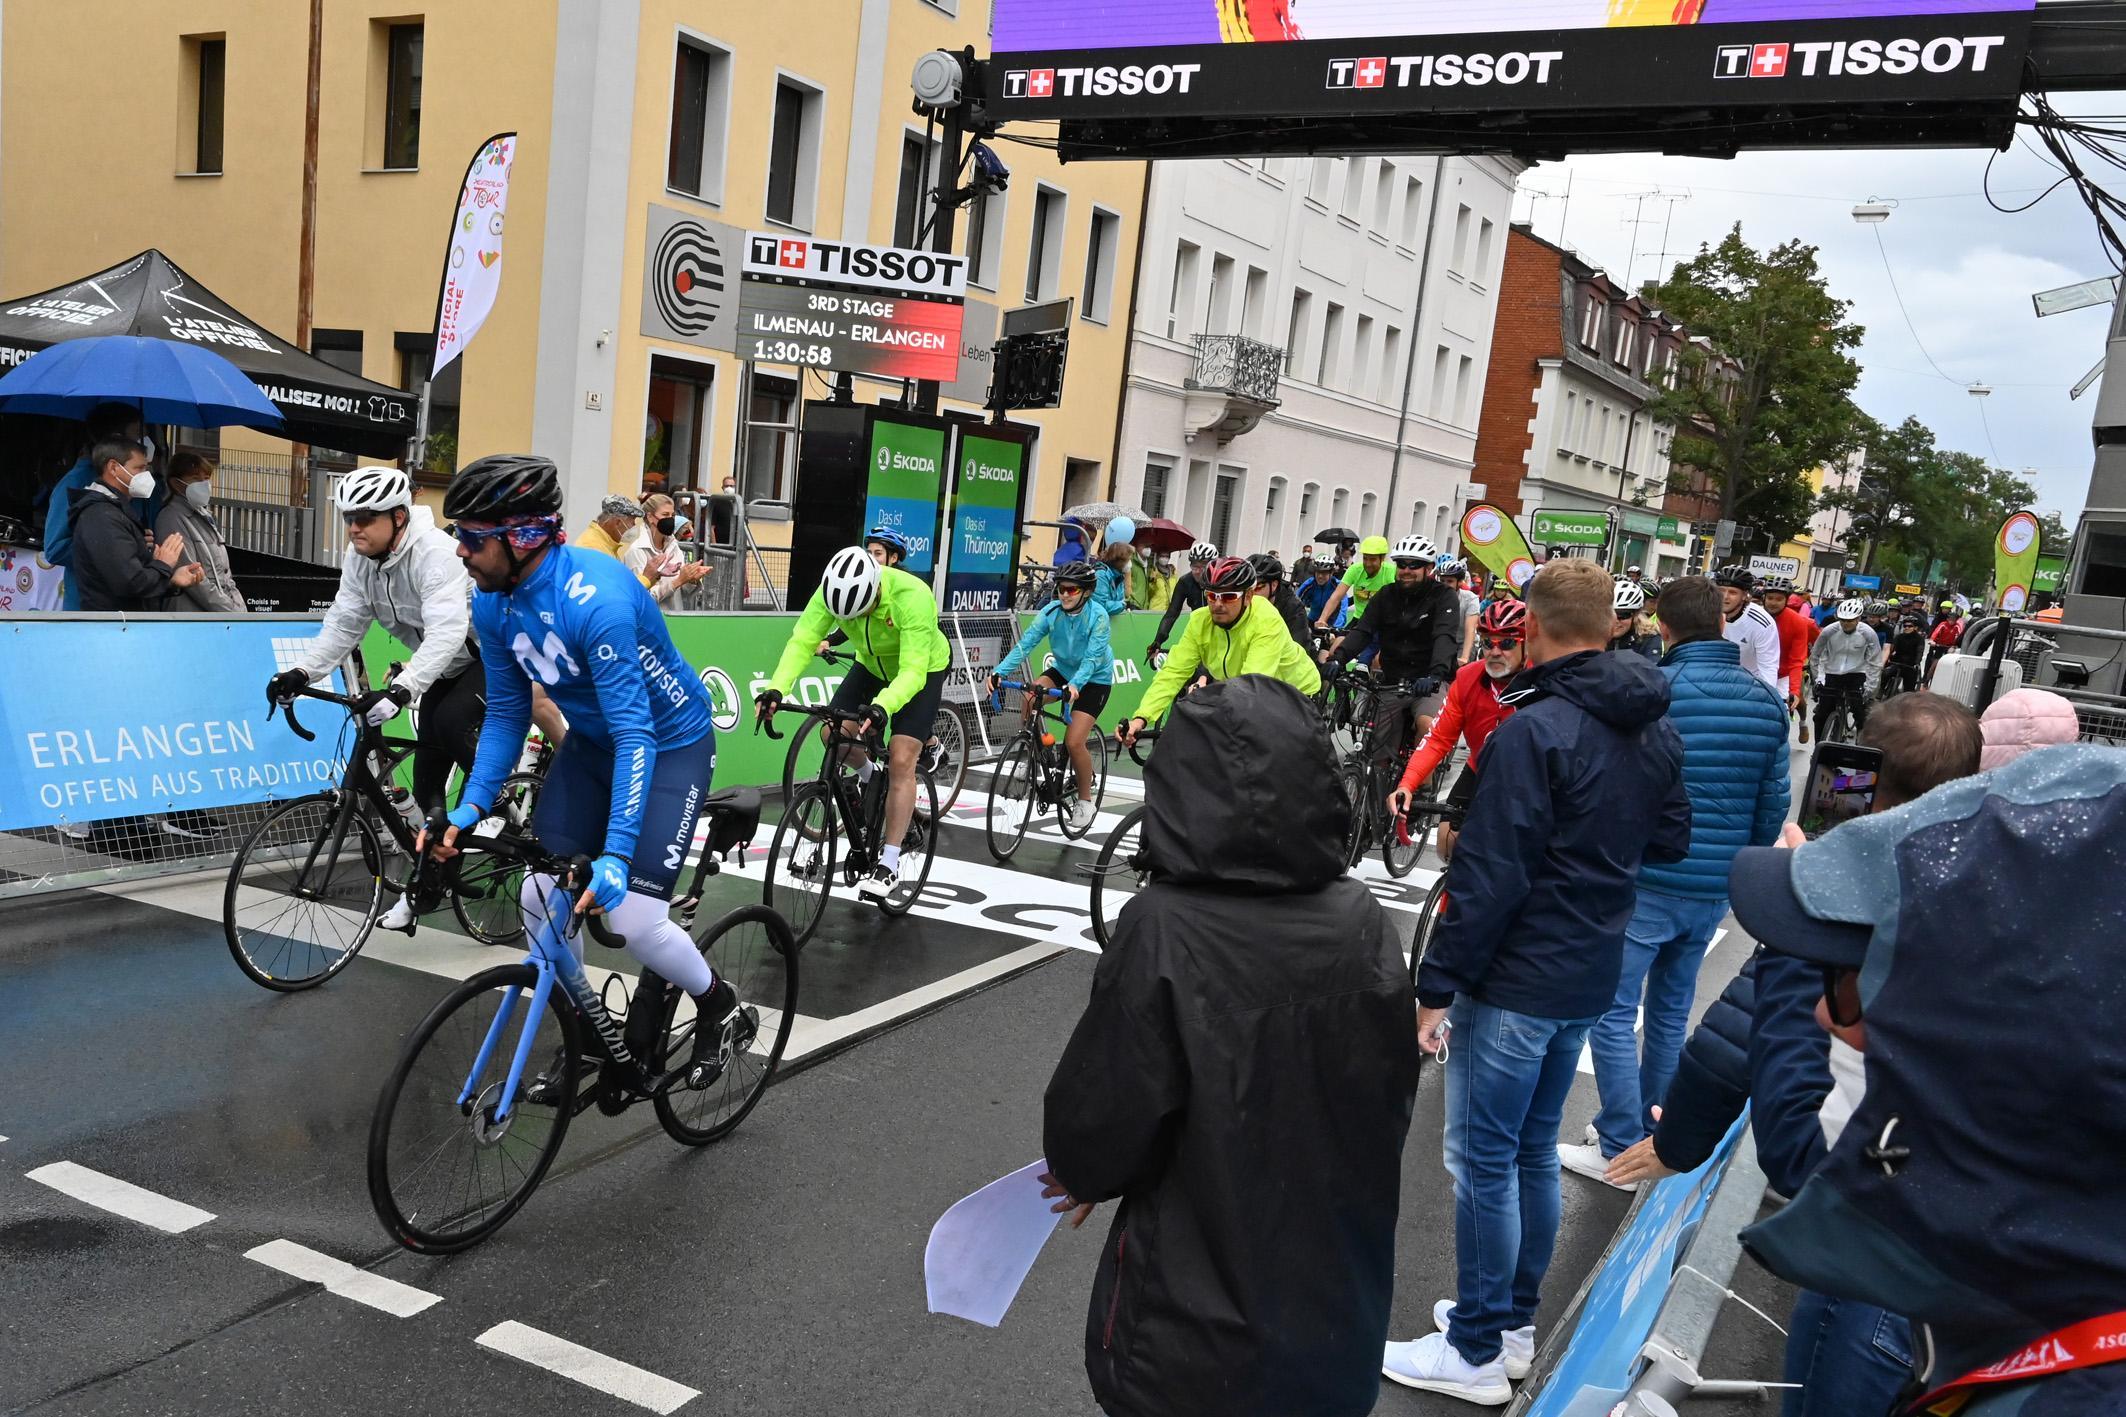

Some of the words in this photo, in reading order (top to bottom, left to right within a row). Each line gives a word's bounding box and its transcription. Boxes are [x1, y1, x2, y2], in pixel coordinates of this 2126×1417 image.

[1390, 51, 1563, 87] TISSOT
[1793, 36, 2005, 76] TISSOT
[1057, 63, 1200, 97] TISSOT
[811, 242, 963, 287] TISSOT
[6, 306, 100, 326] OFFICIEL
[30, 299, 115, 318] L'ATELIER
[440, 277, 455, 350] OFFICIAL
[808, 294, 839, 313] 3RD
[842, 298, 894, 319] STAGE
[162, 315, 261, 341] L'ATELIER
[170, 327, 282, 355] OFFICIEL
[753, 313, 835, 338] ILMENAU
[850, 324, 945, 350] ERLANGEN
[753, 340, 832, 365] 1:30:58
[962, 341, 990, 362] Leben
[256, 384, 322, 408] NALISEZ
[324, 394, 352, 413] MOI
[893, 451, 935, 473] ŠKODA
[978, 463, 1014, 483] ŠKODA
[878, 509, 892, 526] Das
[893, 510, 903, 526] ist
[965, 516, 977, 531] Das
[978, 518, 986, 531] ist
[1554, 522, 1602, 535] ŠKODA
[964, 533, 1009, 560] Thüringen
[1752, 560, 1794, 572] DAUNER
[952, 590, 999, 611] DAUNER
[27, 719, 255, 769] ERLANGEN
[40, 776, 138, 809] OFFEN
[152, 770, 203, 797] AUS
[210, 757, 347, 791] TRADITION
[625, 746, 645, 817] CANYON
[676, 784, 700, 844] movistar
